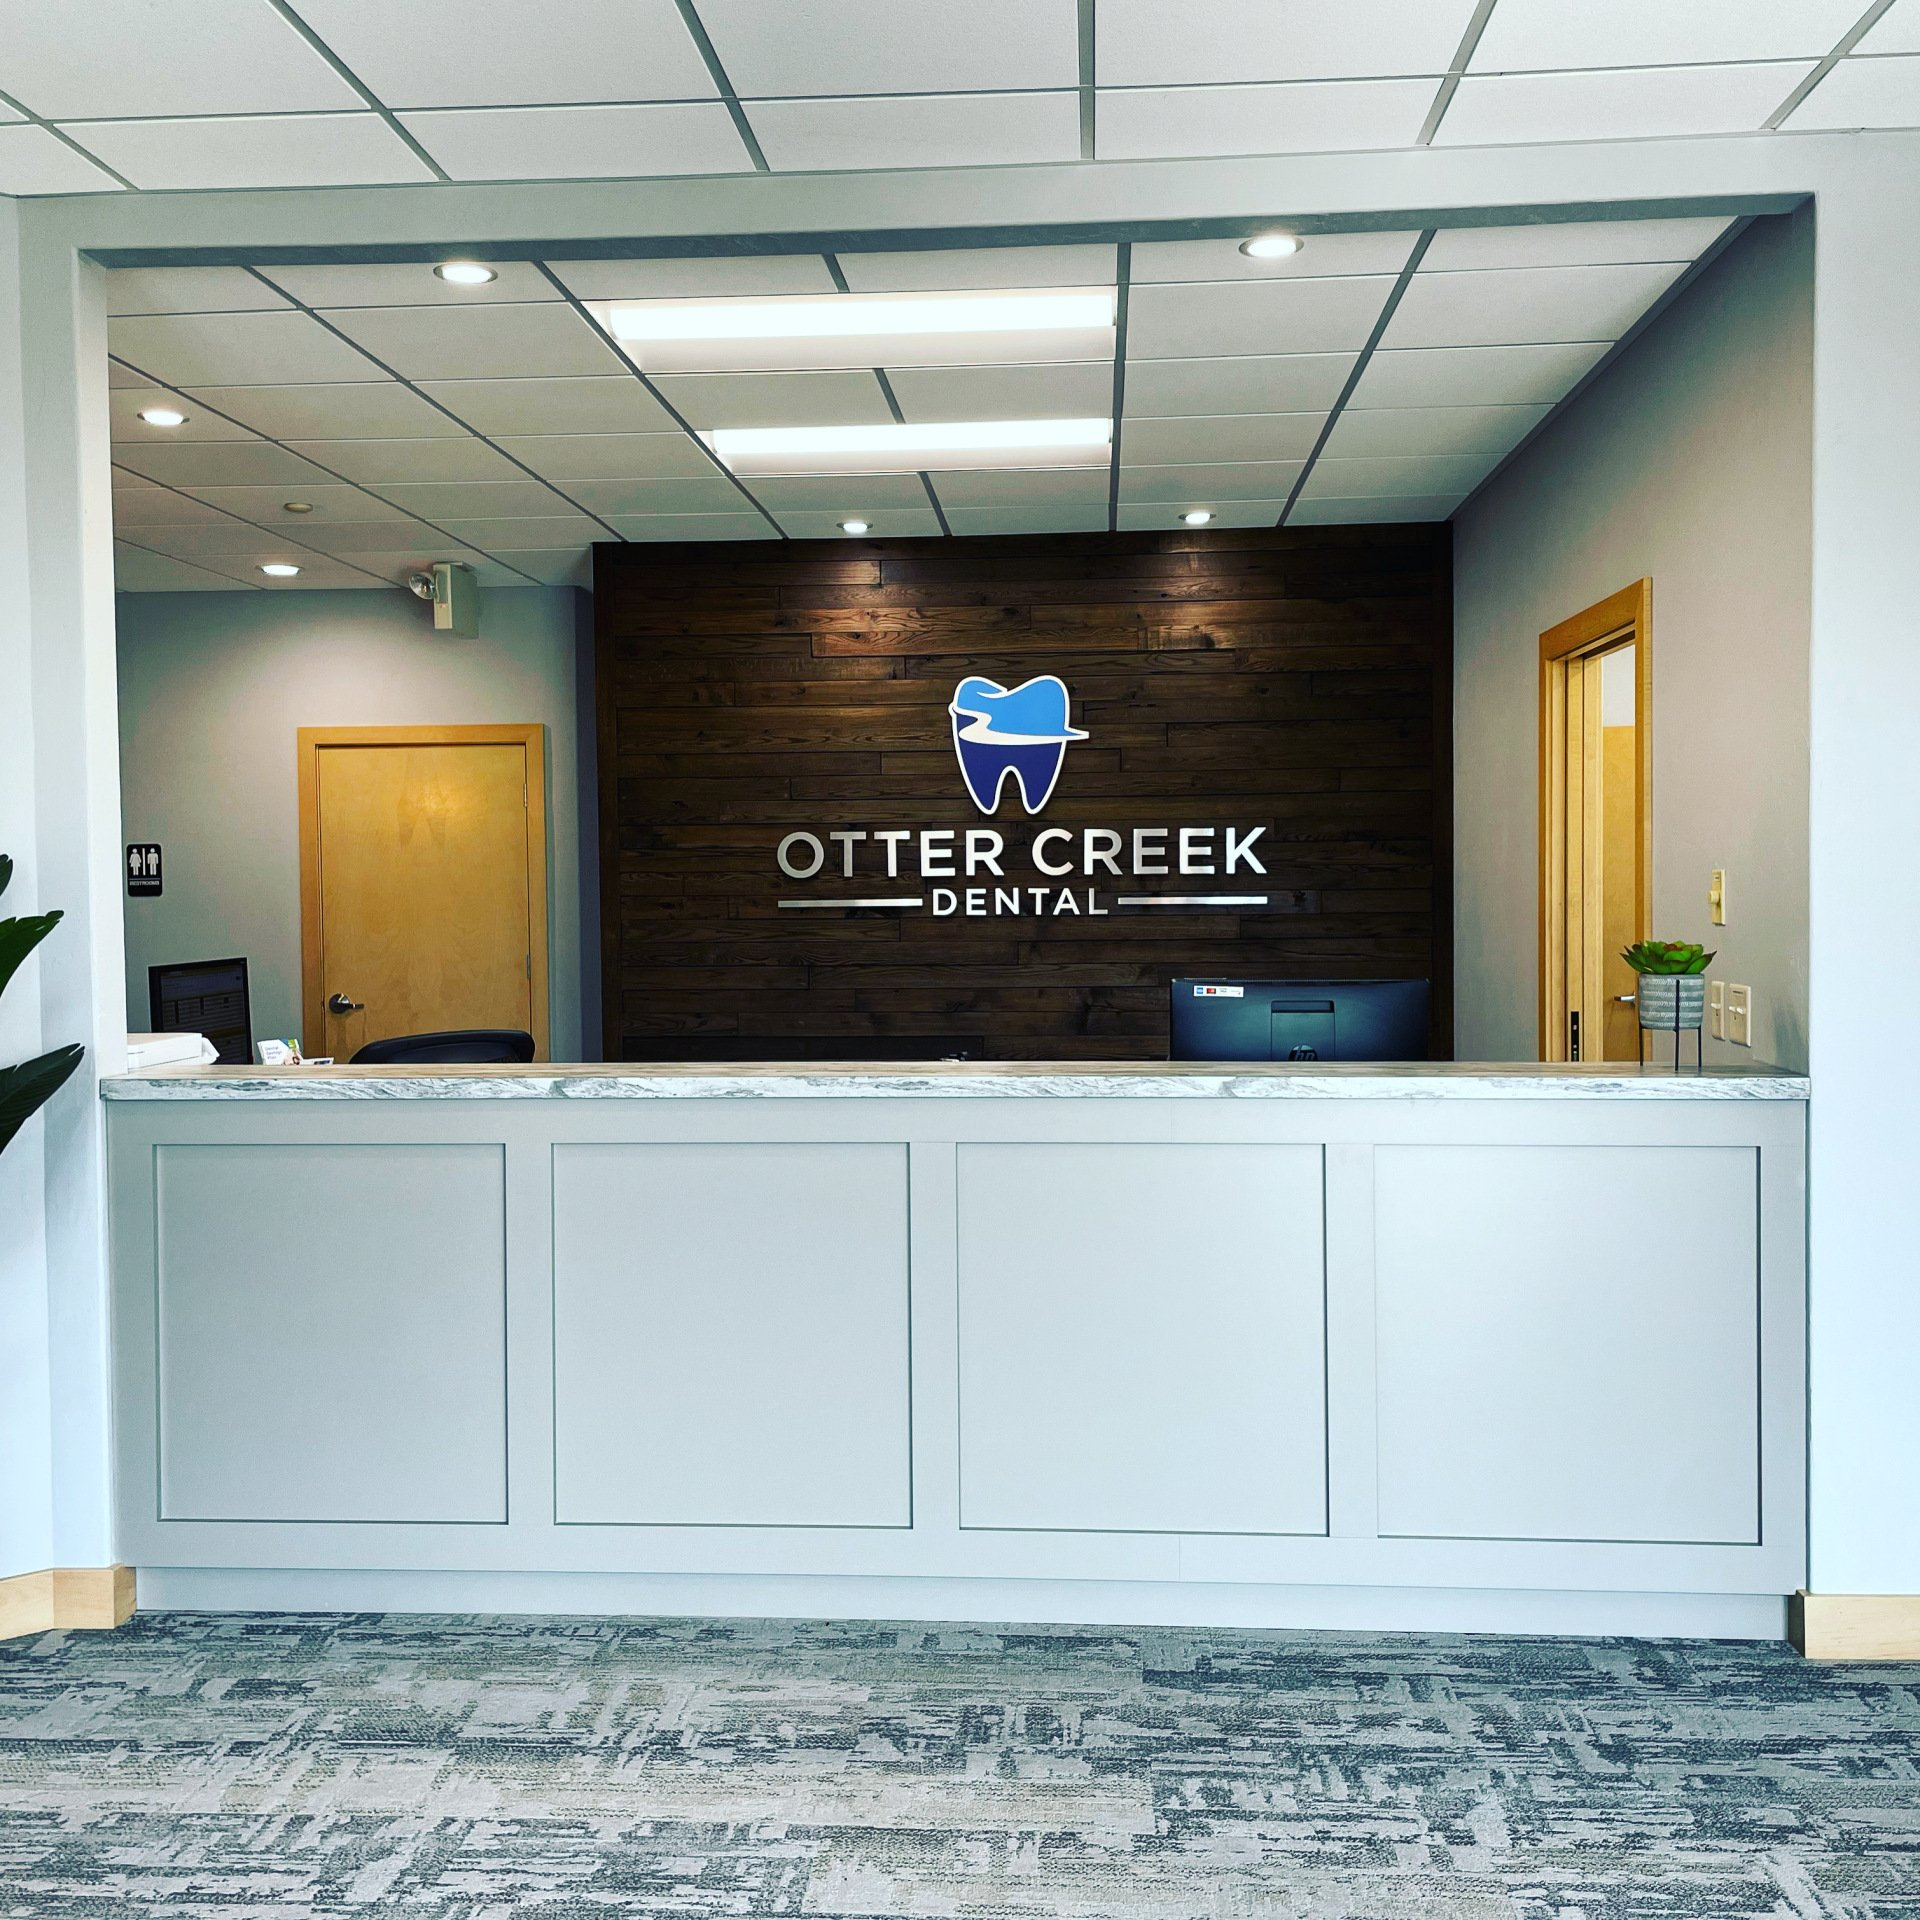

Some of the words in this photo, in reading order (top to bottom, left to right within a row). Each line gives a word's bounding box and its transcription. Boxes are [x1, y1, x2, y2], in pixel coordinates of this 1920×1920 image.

[776, 830, 1005, 879] OTTER
[1031, 827, 1267, 876] CREEK
[932, 887, 1109, 916] DENTAL
